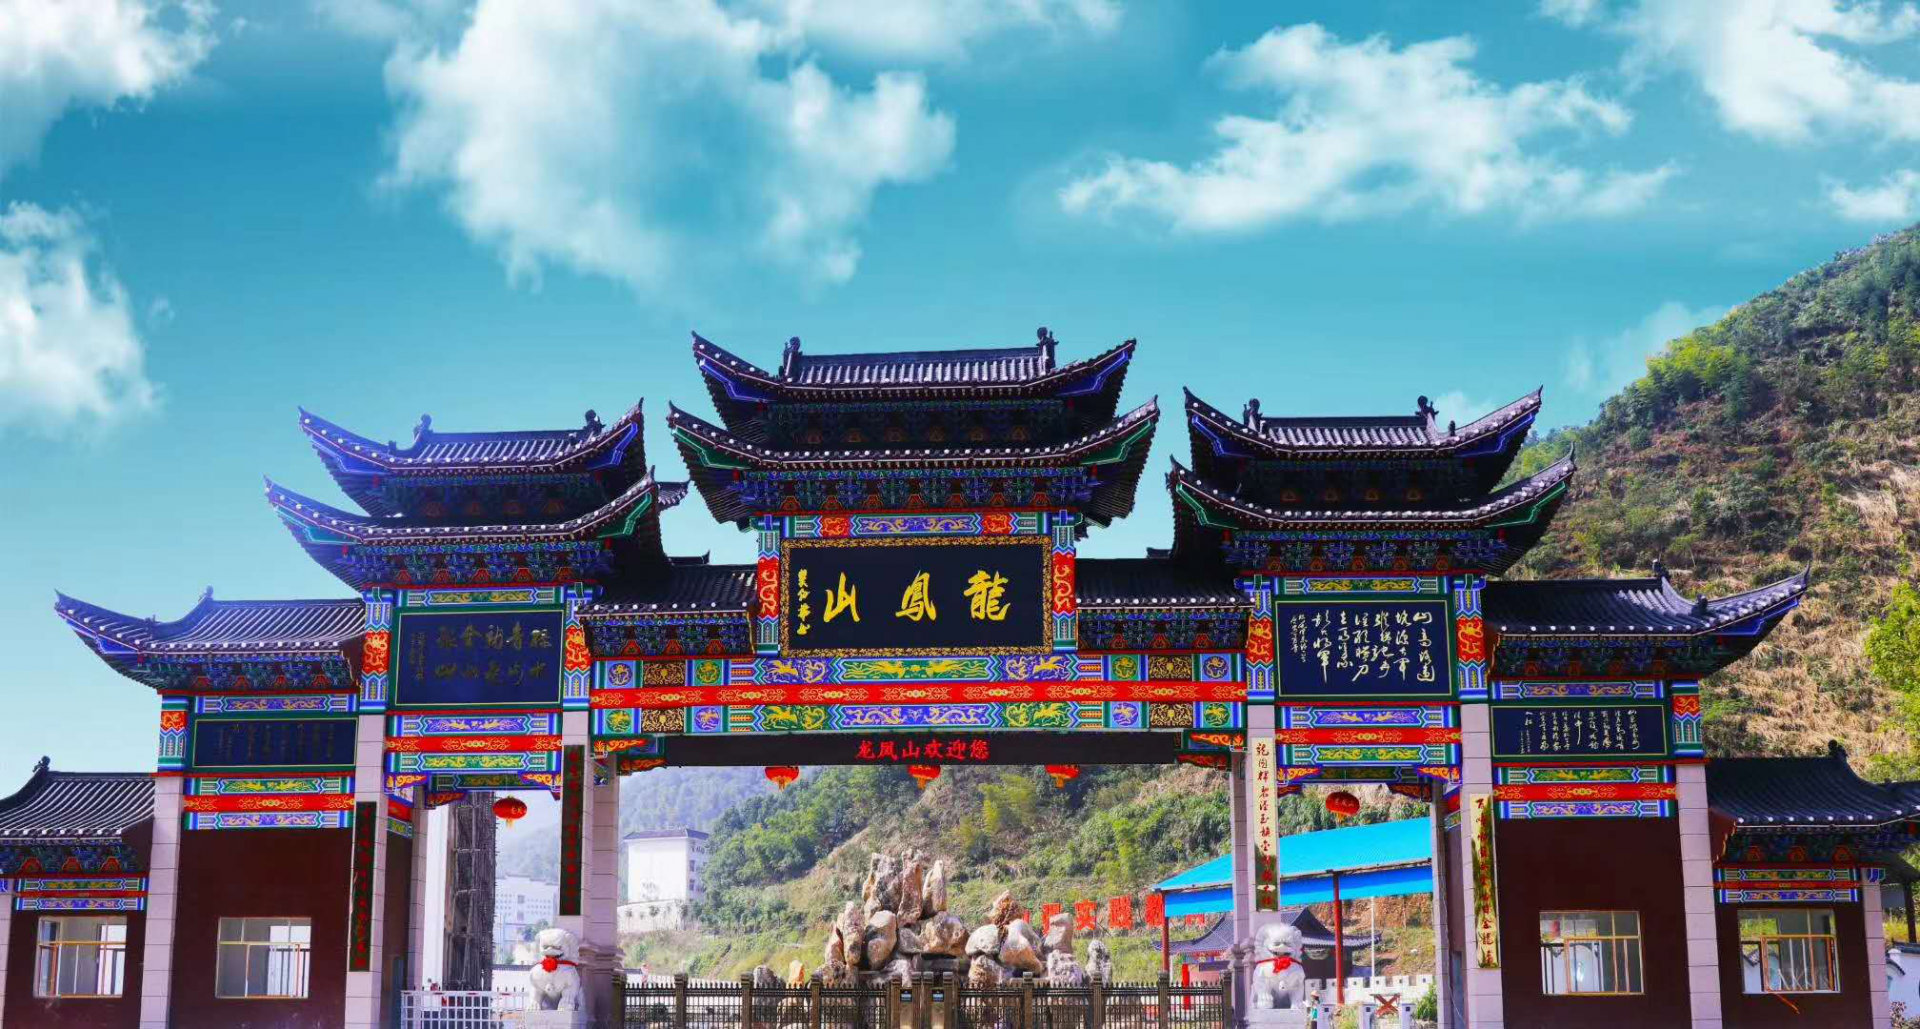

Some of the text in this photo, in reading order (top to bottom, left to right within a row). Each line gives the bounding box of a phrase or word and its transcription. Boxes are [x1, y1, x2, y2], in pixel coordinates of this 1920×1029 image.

[855, 739, 990, 760] 龙凤山欢迎您
